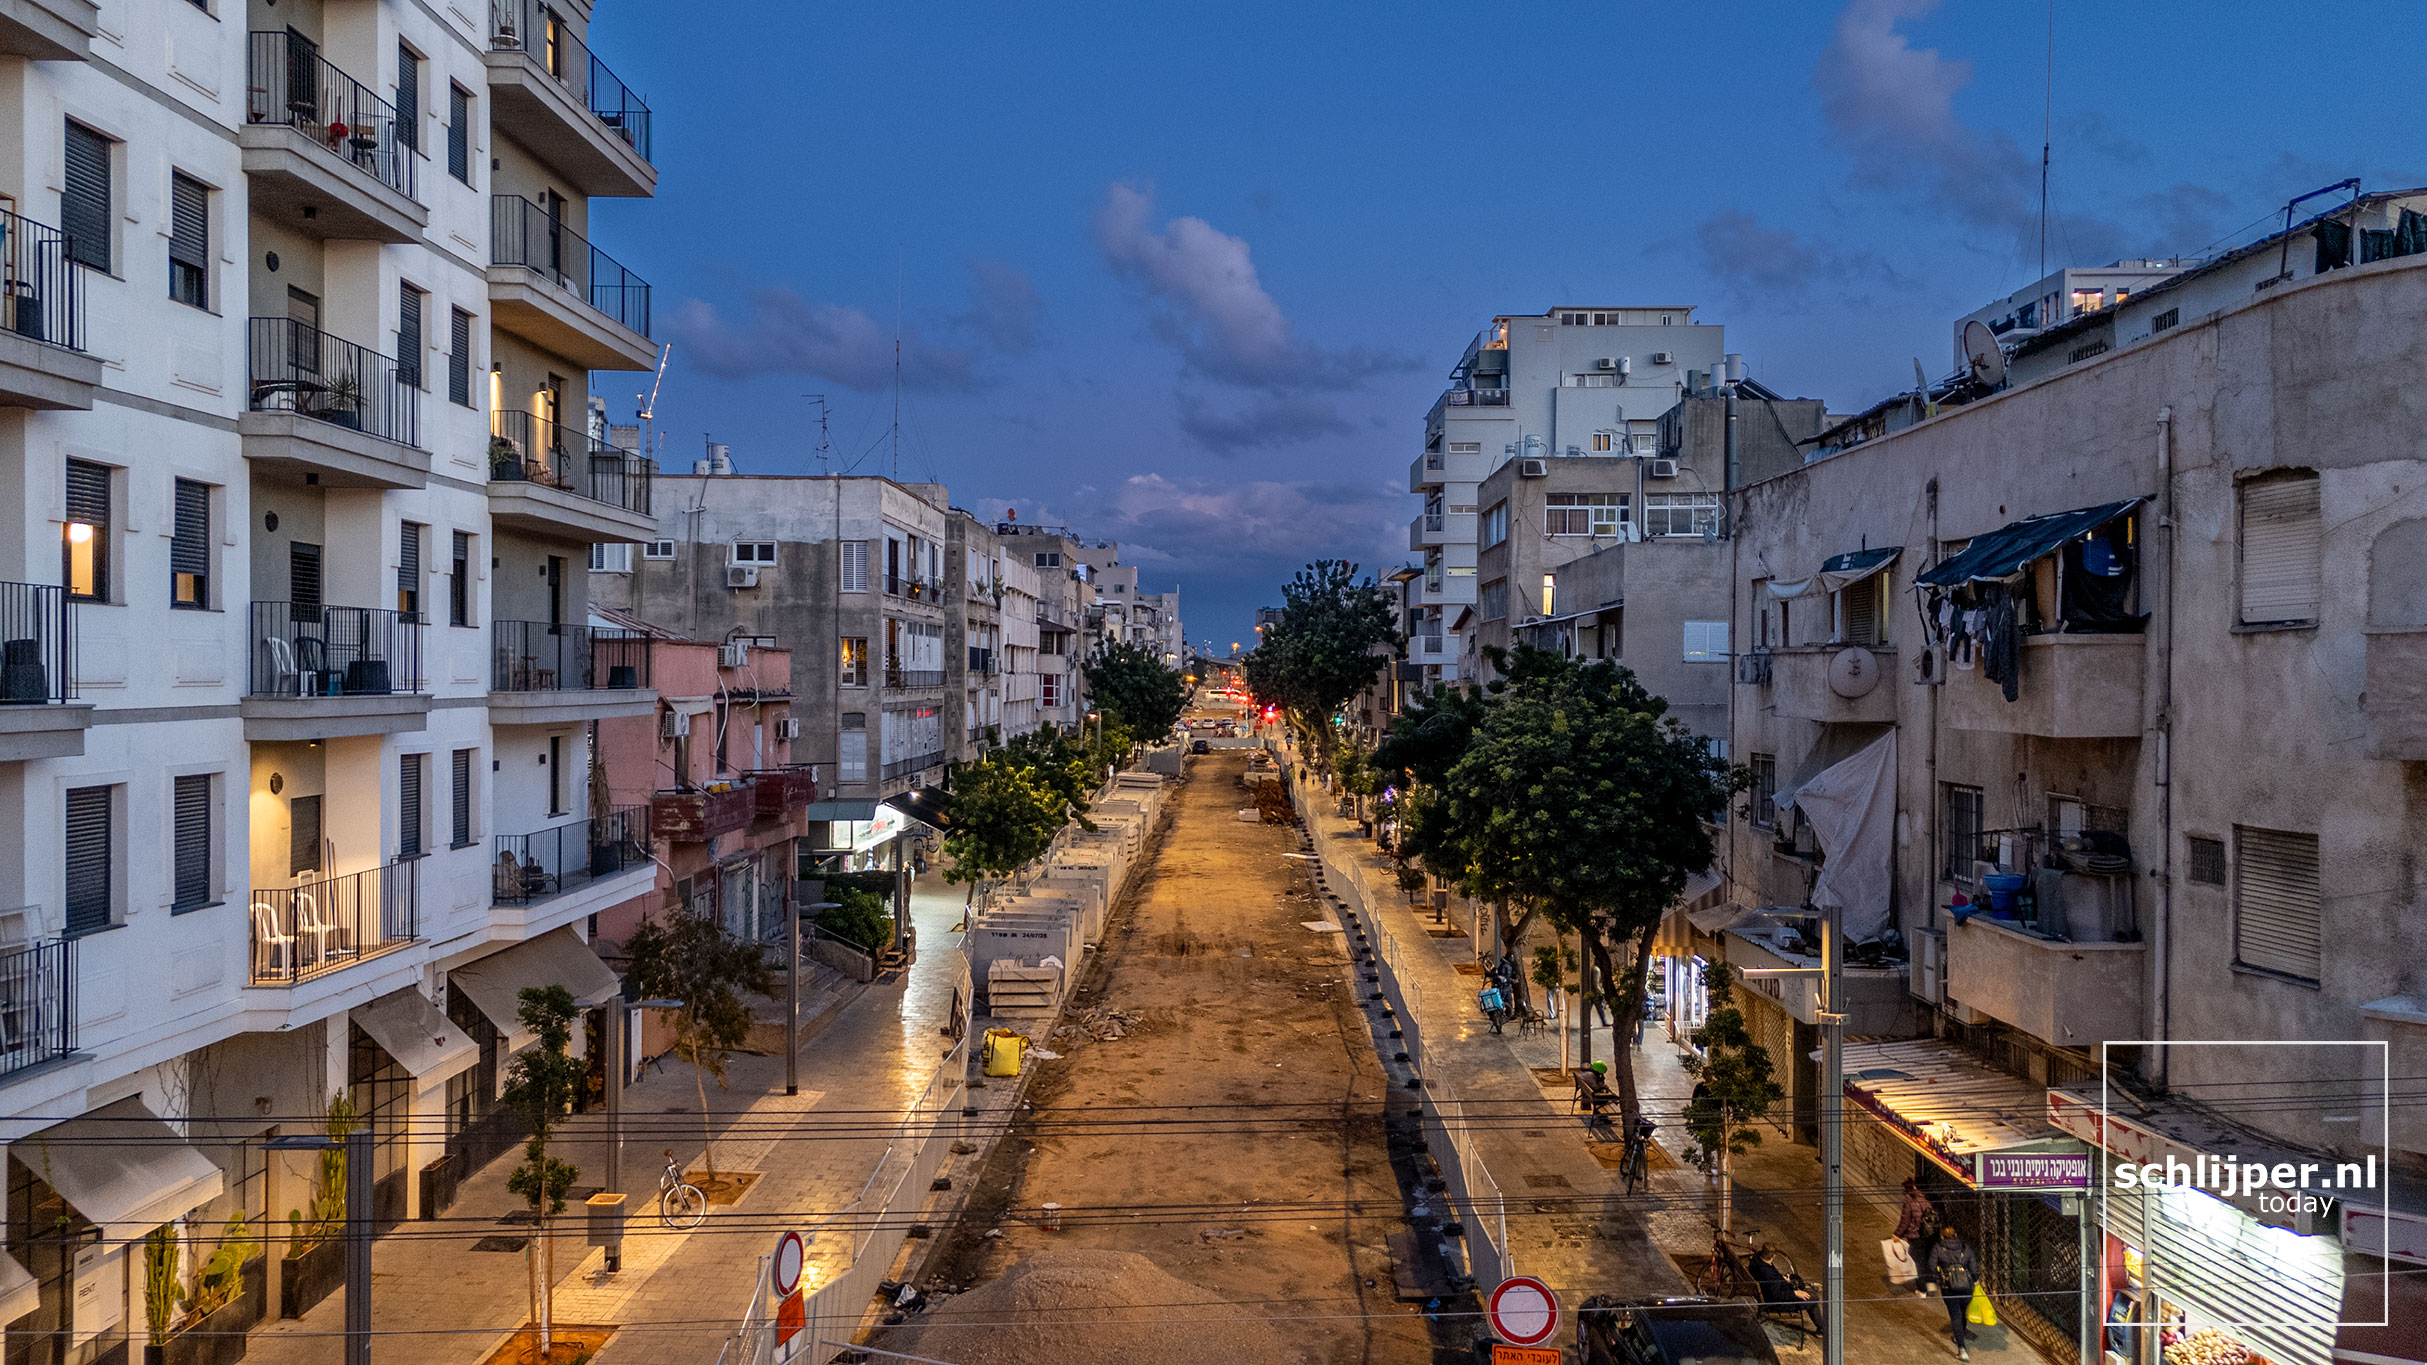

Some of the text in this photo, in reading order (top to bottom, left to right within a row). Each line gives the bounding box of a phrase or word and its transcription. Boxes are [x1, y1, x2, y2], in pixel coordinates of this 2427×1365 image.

[1990, 1159, 2087, 1180] אופטיקה ניסים ובני בכר
[1497, 1350, 1558, 1364] לעובדי האתר
